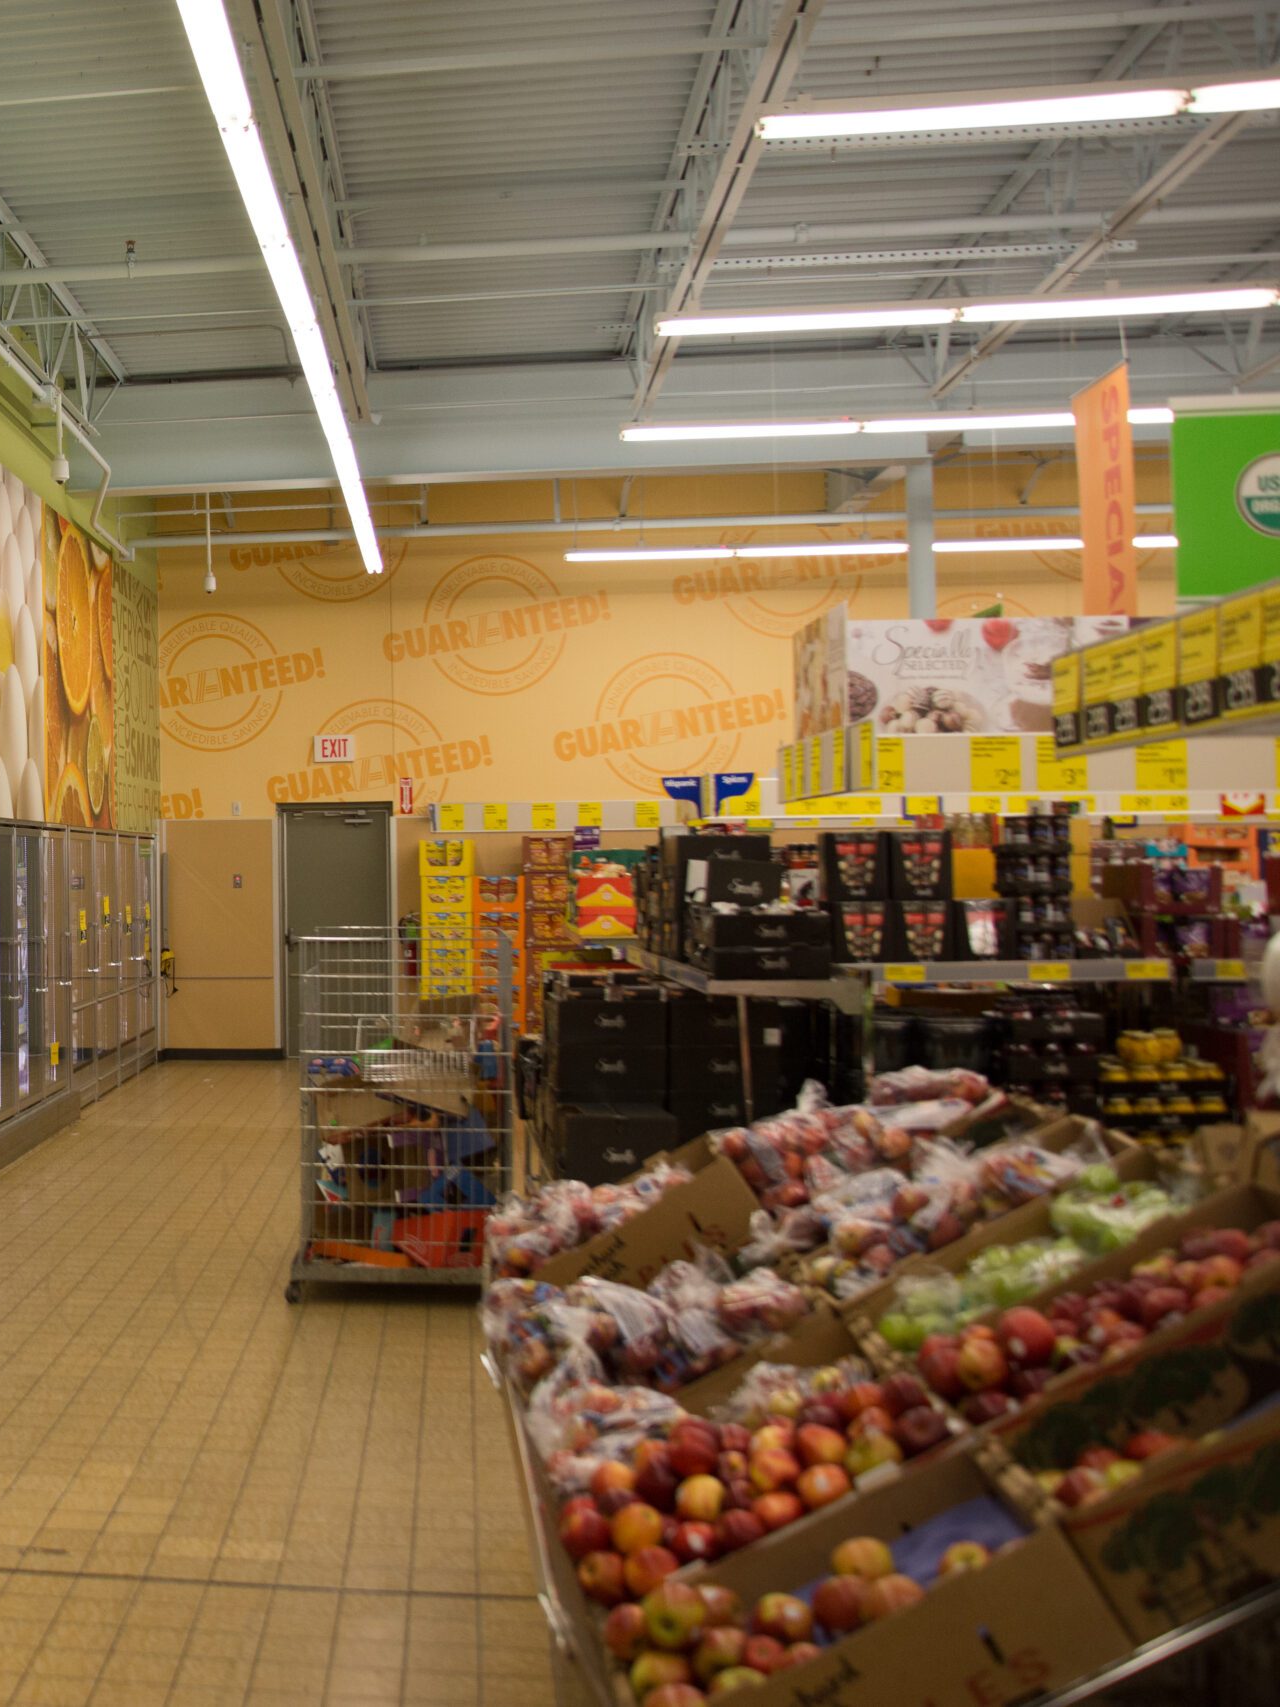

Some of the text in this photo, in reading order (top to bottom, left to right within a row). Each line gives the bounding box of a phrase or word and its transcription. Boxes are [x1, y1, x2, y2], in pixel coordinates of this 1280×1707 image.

[1101, 384, 1126, 616] SPECIA
[219, 621, 265, 650] QUALITY
[168, 701, 273, 746] INCREDIBLE SAVINGS
[322, 738, 348, 758] EXIT
